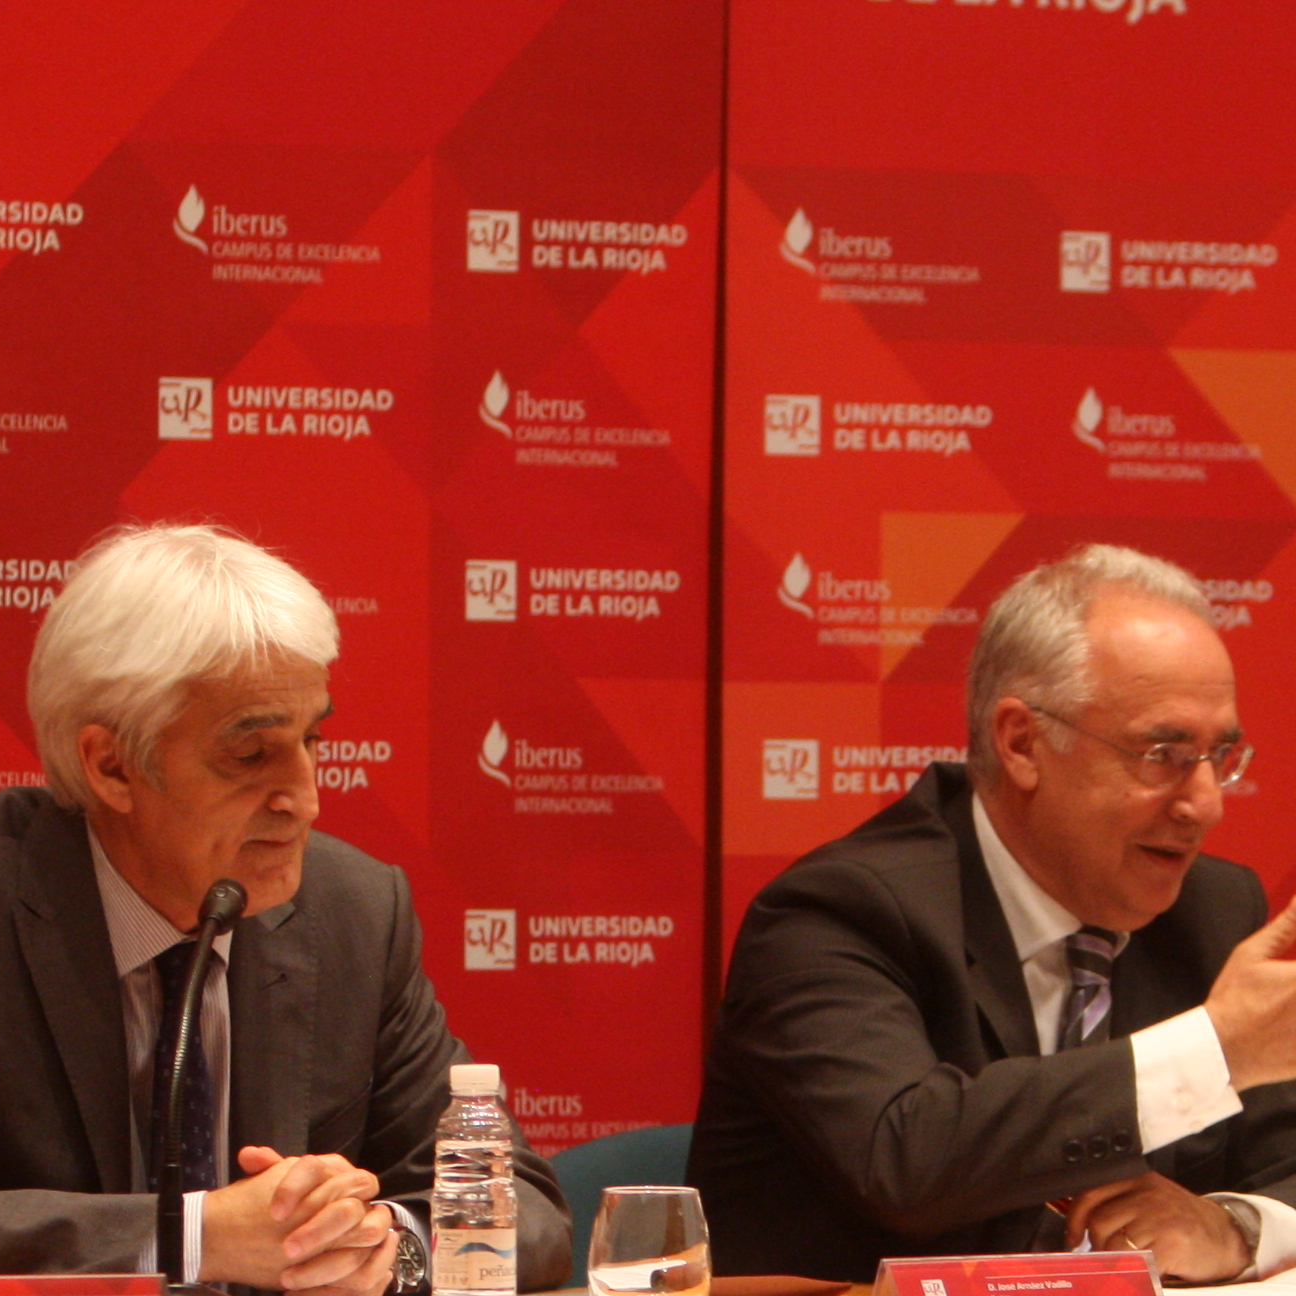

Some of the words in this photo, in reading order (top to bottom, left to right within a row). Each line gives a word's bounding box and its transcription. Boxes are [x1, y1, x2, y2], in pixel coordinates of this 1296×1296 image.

[213, 206, 288, 237] iberus
[532, 220, 687, 245] UNIVERSIDAD
[212, 243, 272, 259] CAMPUS
[276, 244, 293, 260] DE
[298, 245, 381, 262] EXCELENCIA
[532, 245, 563, 267] DE
[568, 247, 598, 268] LA
[603, 248, 666, 274] RIOJA
[1121, 241, 1278, 265] UNIVERSIDAD
[213, 264, 323, 283] INTERNACIONAL
[1121, 265, 1151, 287] DE
[1157, 267, 1189, 288] LA
[1192, 268, 1256, 293] RIOJA
[228, 386, 394, 412] UNIVERSIDAD
[516, 390, 586, 421] iberus
[228, 412, 259, 434] DE
[266, 414, 297, 434] LA
[303, 414, 371, 440] RIOJA
[834, 403, 992, 427] UNIVERSIDAD
[834, 429, 866, 450] DE
[871, 430, 902, 451] LA
[906, 430, 971, 456] RIOJA
[530, 569, 680, 593] UNIVERSIDAD
[530, 594, 559, 615] DE
[565, 595, 594, 616] LA
[598, 595, 660, 621] RIOJA
[515, 739, 583, 769] iberus
[317, 766, 368, 792] IOJA
[833, 772, 864, 793] DE
[869, 773, 900, 793] LA
[529, 916, 674, 937] UNIVERSIDAD
[529, 942, 557, 963] DE
[563, 943, 591, 963] LA
[595, 942, 654, 967] RIOJA
[515, 1088, 582, 1116] iberus
